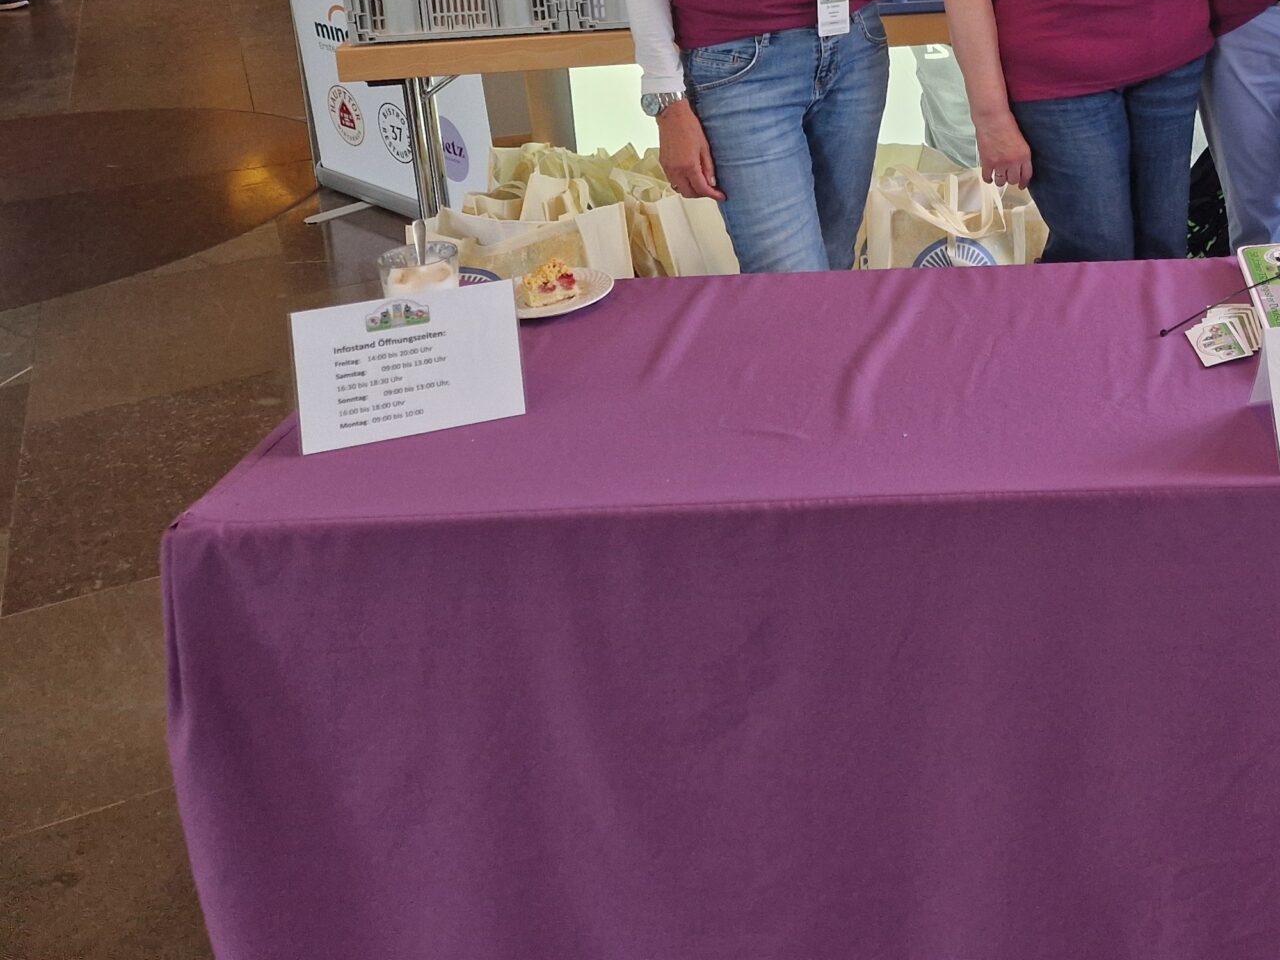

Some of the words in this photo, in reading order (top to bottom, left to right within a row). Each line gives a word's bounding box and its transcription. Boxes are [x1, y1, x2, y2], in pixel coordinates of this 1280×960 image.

[382, 108, 406, 126] BISTRO
[390, 124, 402, 142] 37
[442, 139, 465, 159] etz
[333, 341, 376, 355] Infostand
[378, 331, 447, 347] Öffnungszeiten:
[368, 353, 387, 362] 14:00
[388, 351, 398, 359] bis
[400, 348, 419, 357] 20:00
[381, 364, 401, 372] 09:00
[402, 361, 412, 369] bis
[358, 381, 368, 389] bis
[383, 387, 403, 396] 09:00
[405, 385, 415, 393] bis
[360, 406, 370, 414] bis
[372, 403, 391, 411] 18:00
[392, 400, 406, 408] Uhr
[372, 415, 392, 423] 09:00
[393, 412, 403, 420] bis
[405, 409, 424, 417] 10:00
